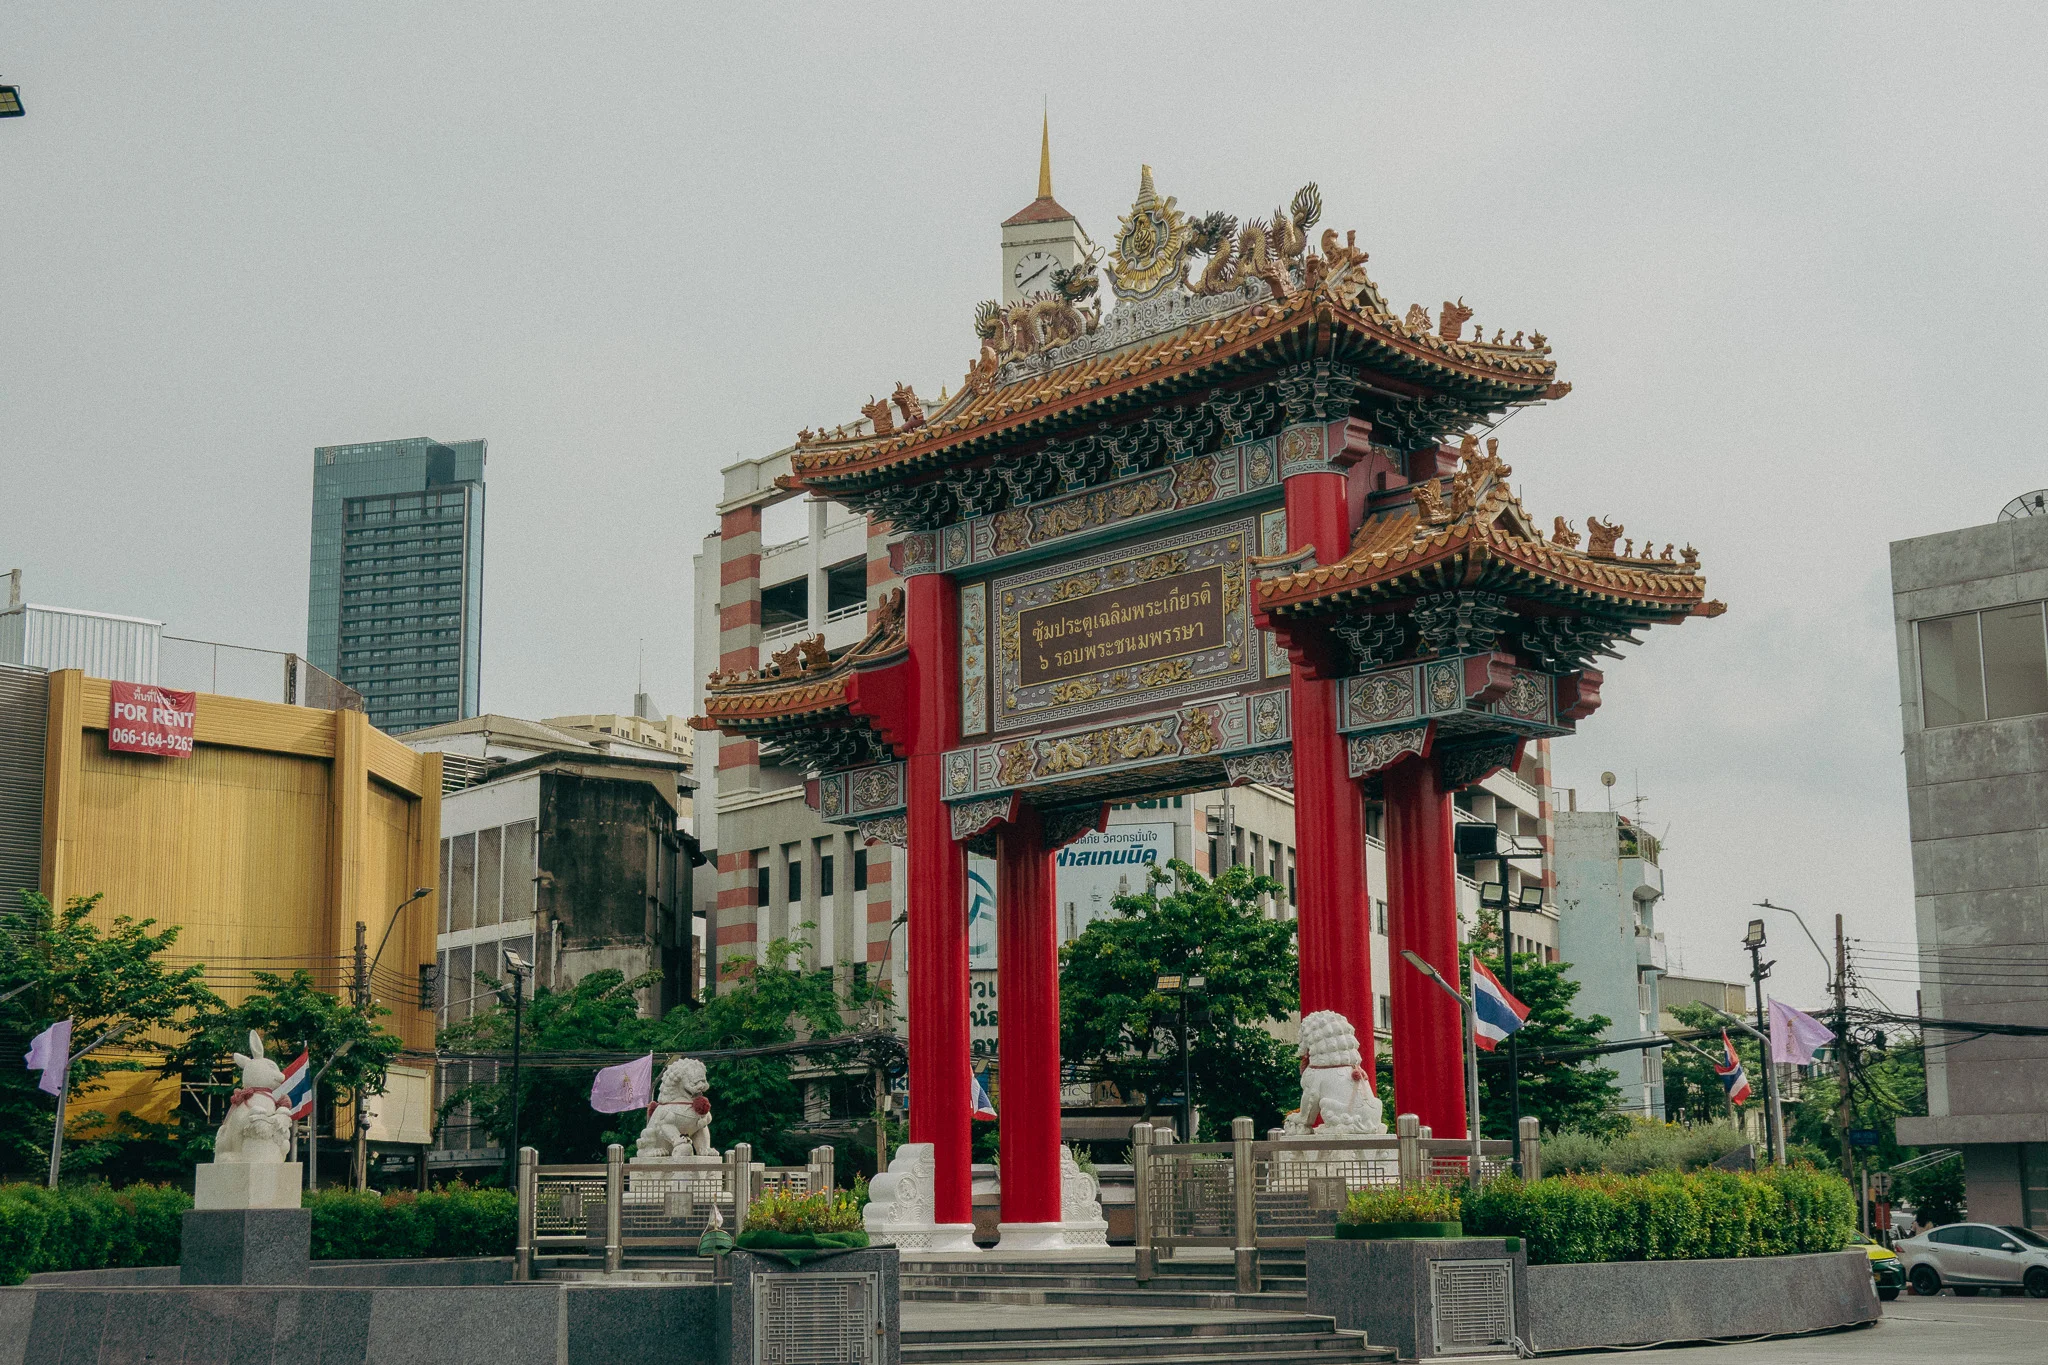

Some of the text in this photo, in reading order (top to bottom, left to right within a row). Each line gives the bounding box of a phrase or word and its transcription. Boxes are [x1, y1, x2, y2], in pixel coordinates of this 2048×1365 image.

[1032, 582, 1211, 648] ซุ้มประตูเฉลิมพระเกียรติ
[1039, 621, 1204, 670] ๖ รอบพระชนมพรรษา
[114, 702, 194, 728] FOR RENT
[112, 727, 193, 752] 066-164-9263
